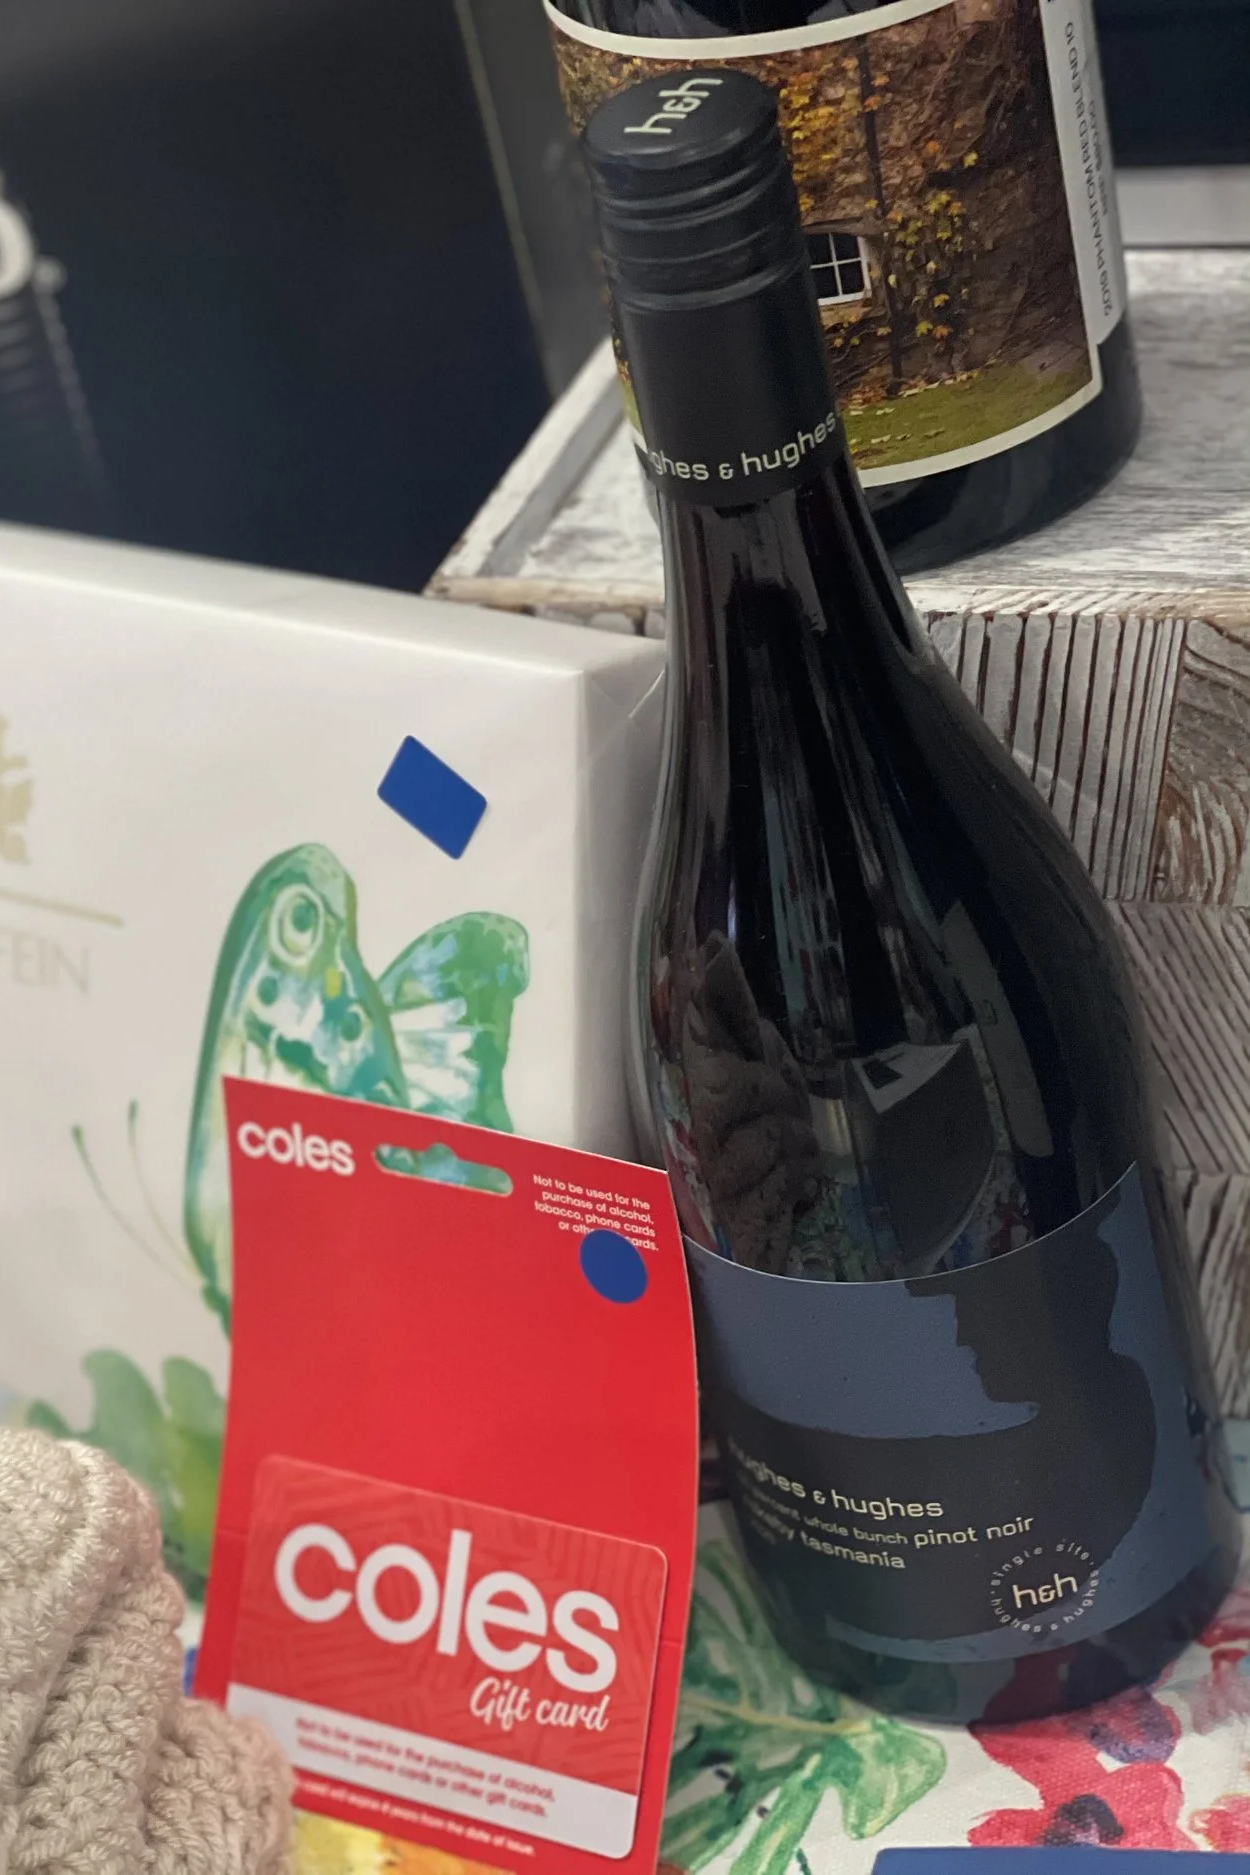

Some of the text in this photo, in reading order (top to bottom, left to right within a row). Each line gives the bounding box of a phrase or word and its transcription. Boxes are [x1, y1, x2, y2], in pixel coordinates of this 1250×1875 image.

[1068, 47, 1084, 119] BLEND
[624, 78, 724, 134] h&h
[1078, 119, 1091, 164] RED
[1083, 163, 1104, 270] PHANTOM
[651, 411, 837, 481] ghes & hughes
[237, 1121, 356, 1176] coles
[533, 1174, 651, 1210] Not to be used for the
[542, 1191, 654, 1225] purchase of alcohol,
[534, 1200, 656, 1238] tobacco, phone cards
[558, 1220, 569, 1231] or
[813, 1490, 826, 1505] &
[831, 1489, 944, 1521] hughes
[800, 1529, 906, 1569] tasmania
[803, 1515, 849, 1537] whole
[853, 1526, 908, 1545] bunch
[913, 1527, 979, 1549] pinot
[986, 1516, 1034, 1541] noir
[274, 1523, 619, 1693] coles
[1012, 1573, 1078, 1609] h&h
[469, 1677, 610, 1732] Gift card
